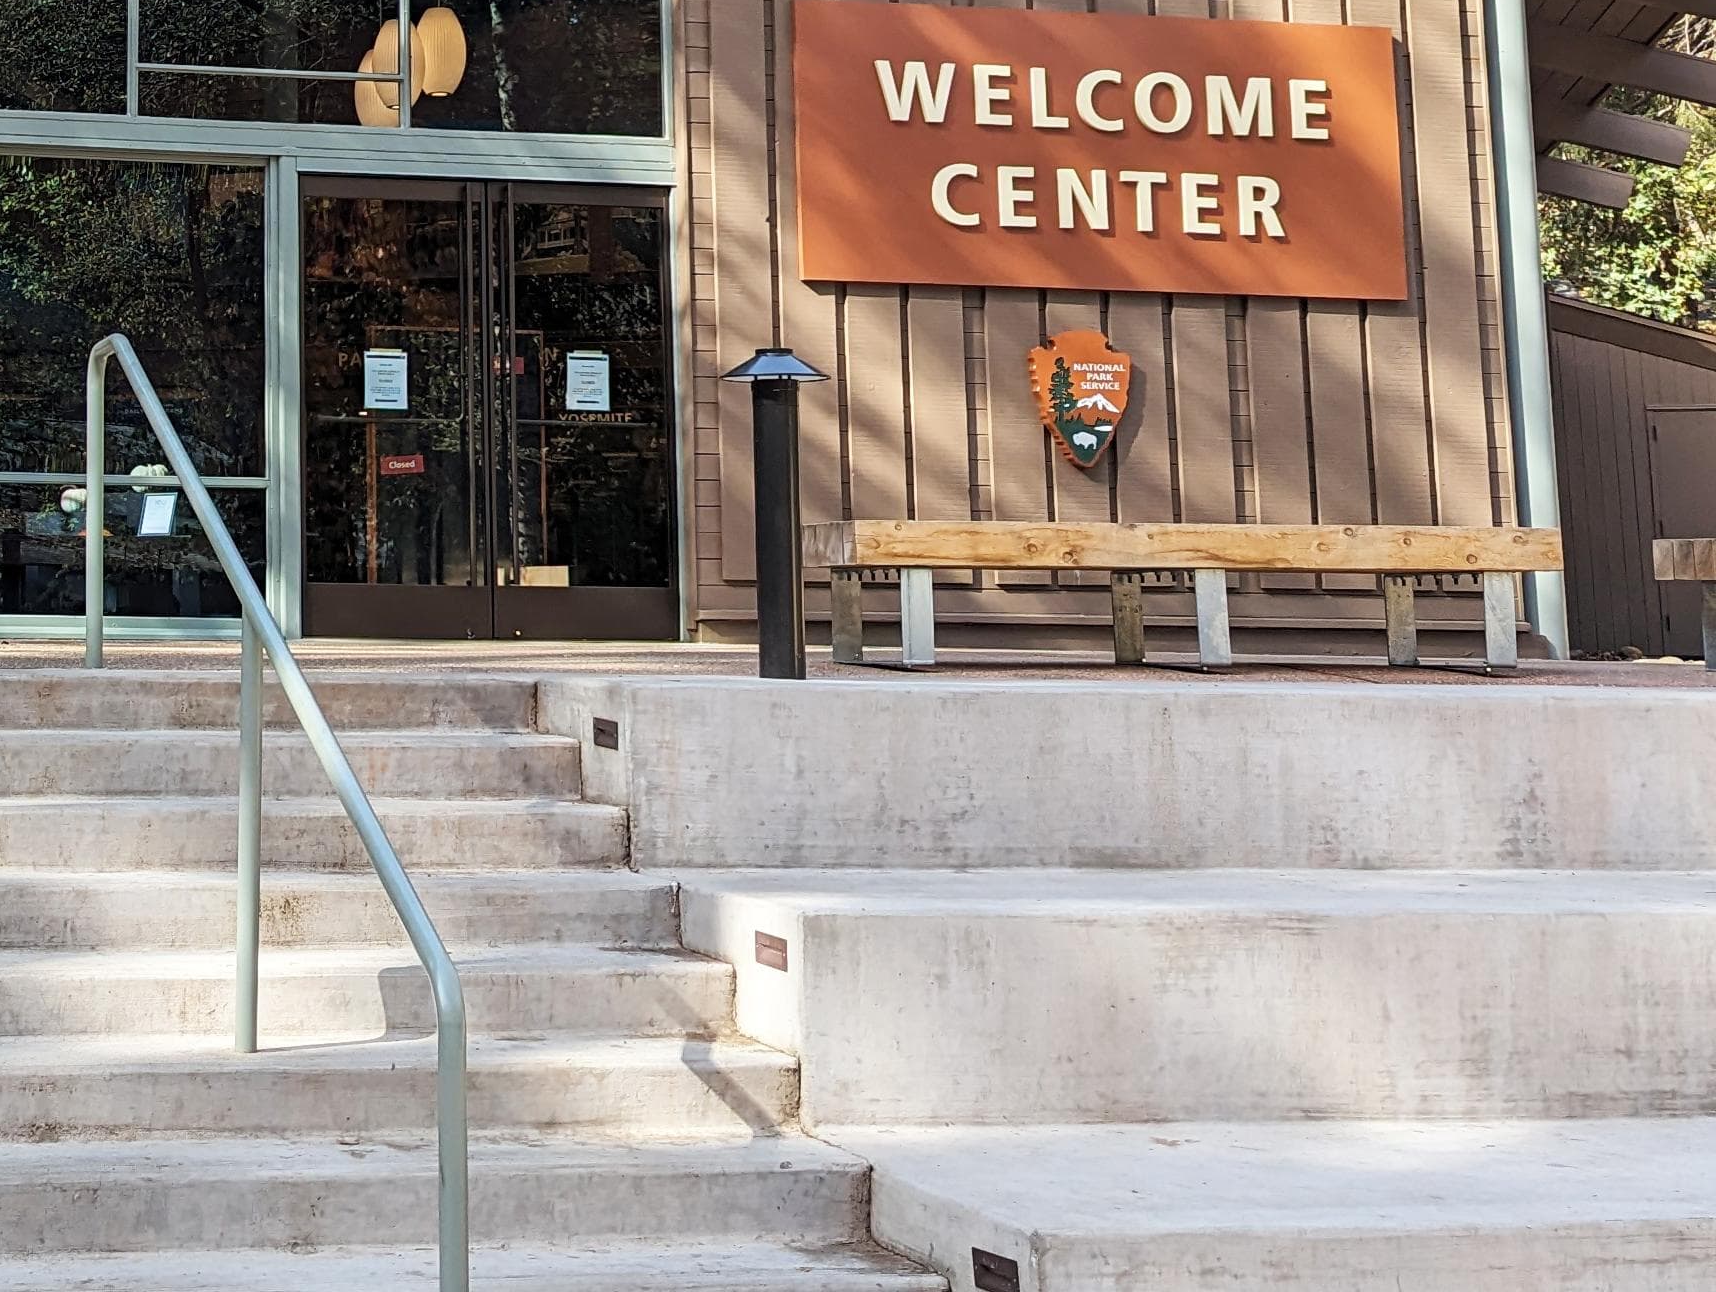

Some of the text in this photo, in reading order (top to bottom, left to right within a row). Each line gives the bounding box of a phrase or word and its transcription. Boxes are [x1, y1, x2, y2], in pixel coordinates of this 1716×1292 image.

[874, 59, 1330, 140] WELCOME
[931, 163, 1286, 238] CENTER
[1073, 363, 1126, 372] NATIONAL
[1086, 373, 1113, 381] PARK
[1080, 381, 1120, 390] SERVICE
[388, 460, 415, 469] Closed
